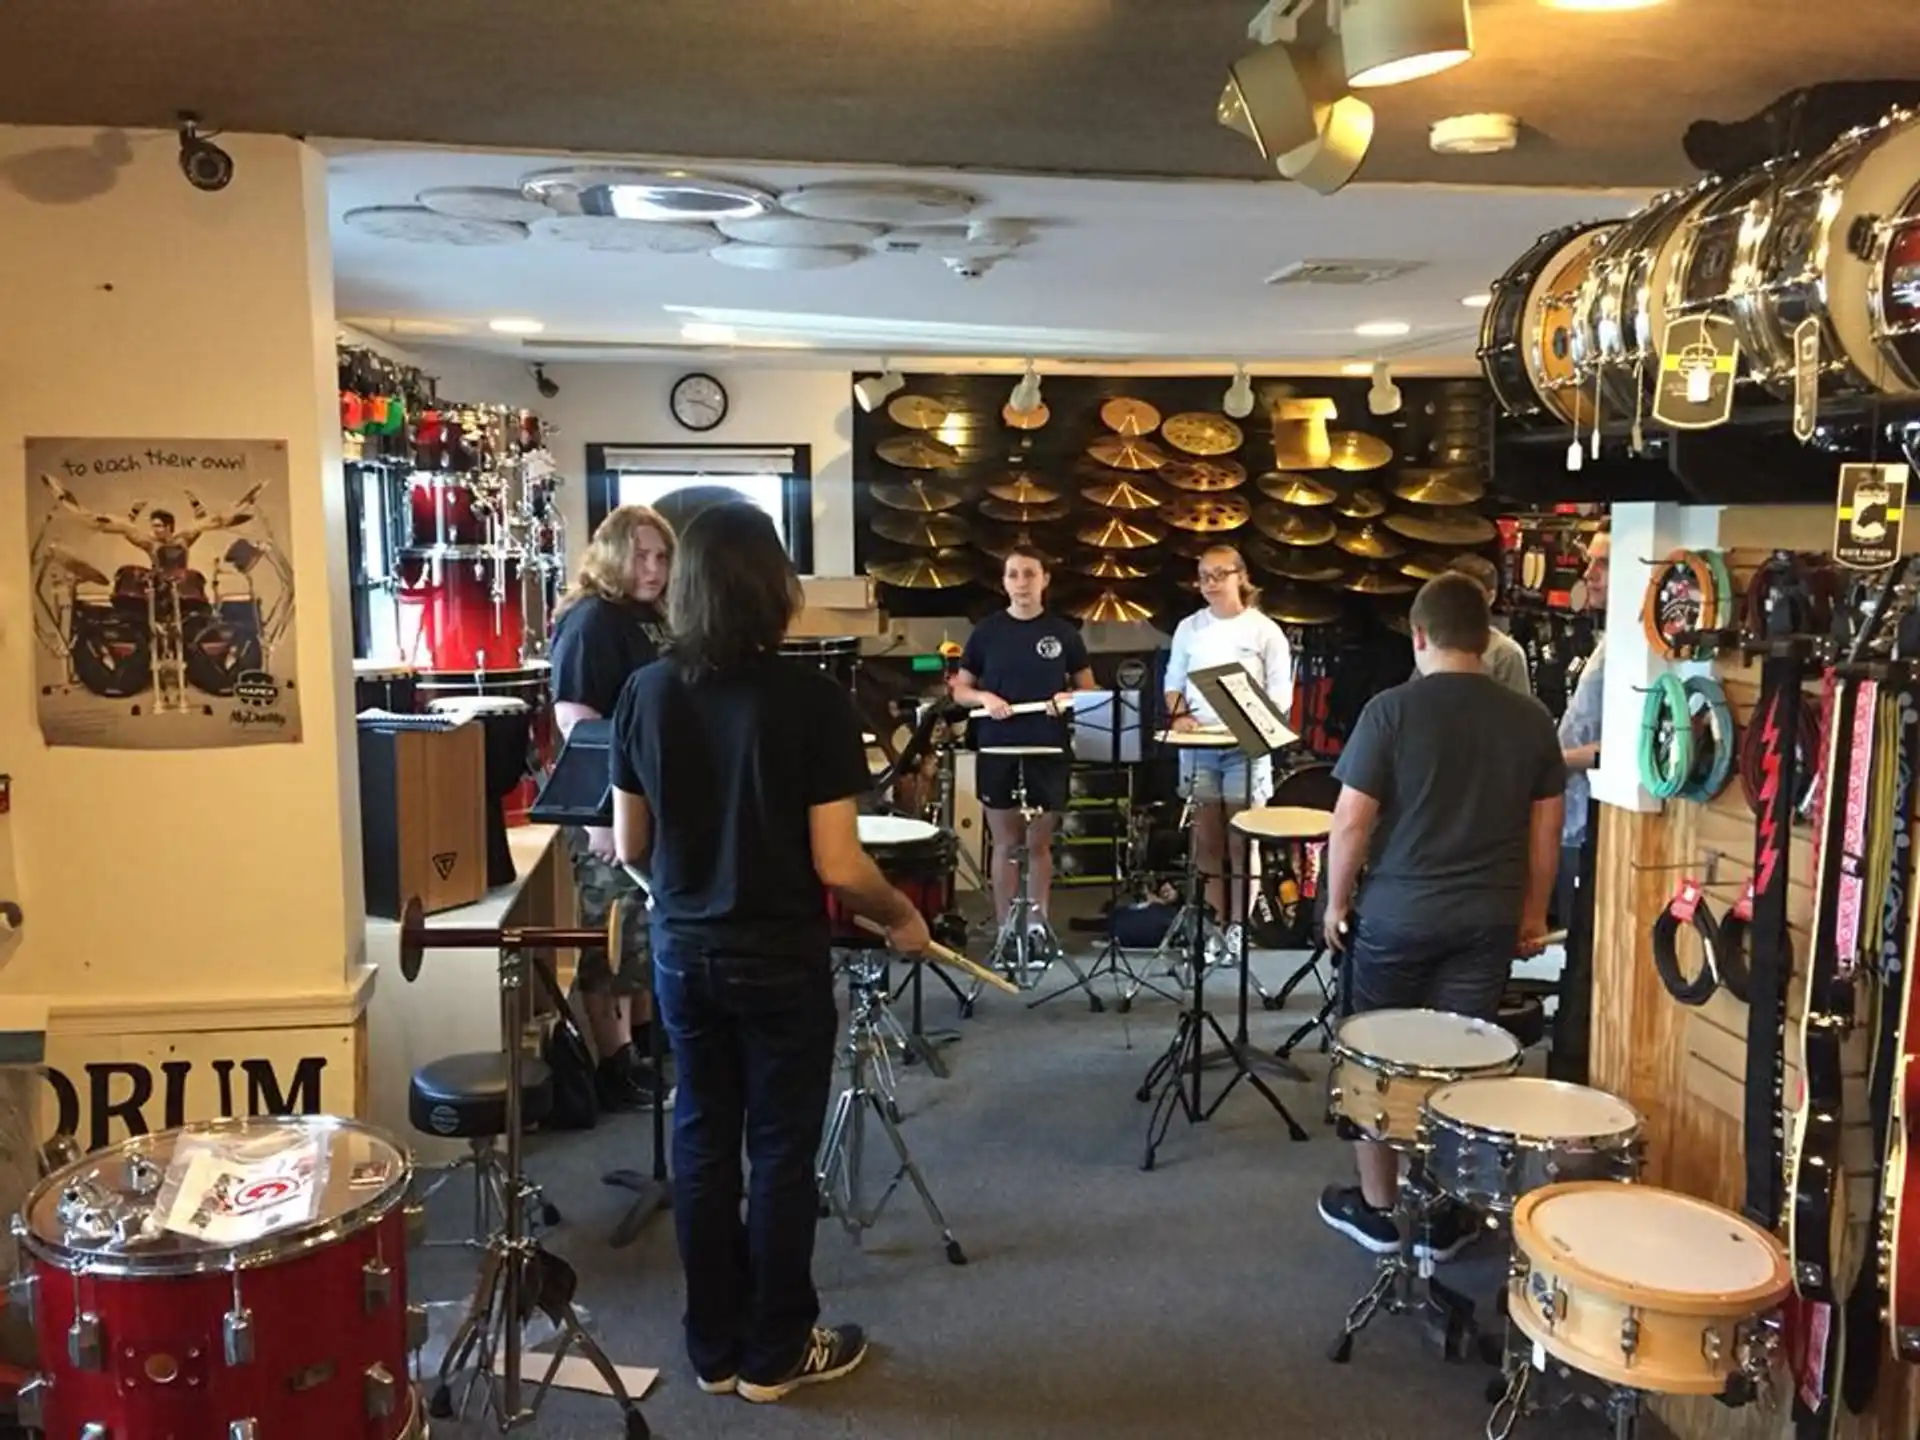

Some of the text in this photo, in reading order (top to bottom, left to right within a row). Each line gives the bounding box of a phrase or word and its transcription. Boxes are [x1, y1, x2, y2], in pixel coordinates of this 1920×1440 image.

[61, 459, 87, 477] to
[93, 454, 142, 475] each
[144, 448, 198, 469] their
